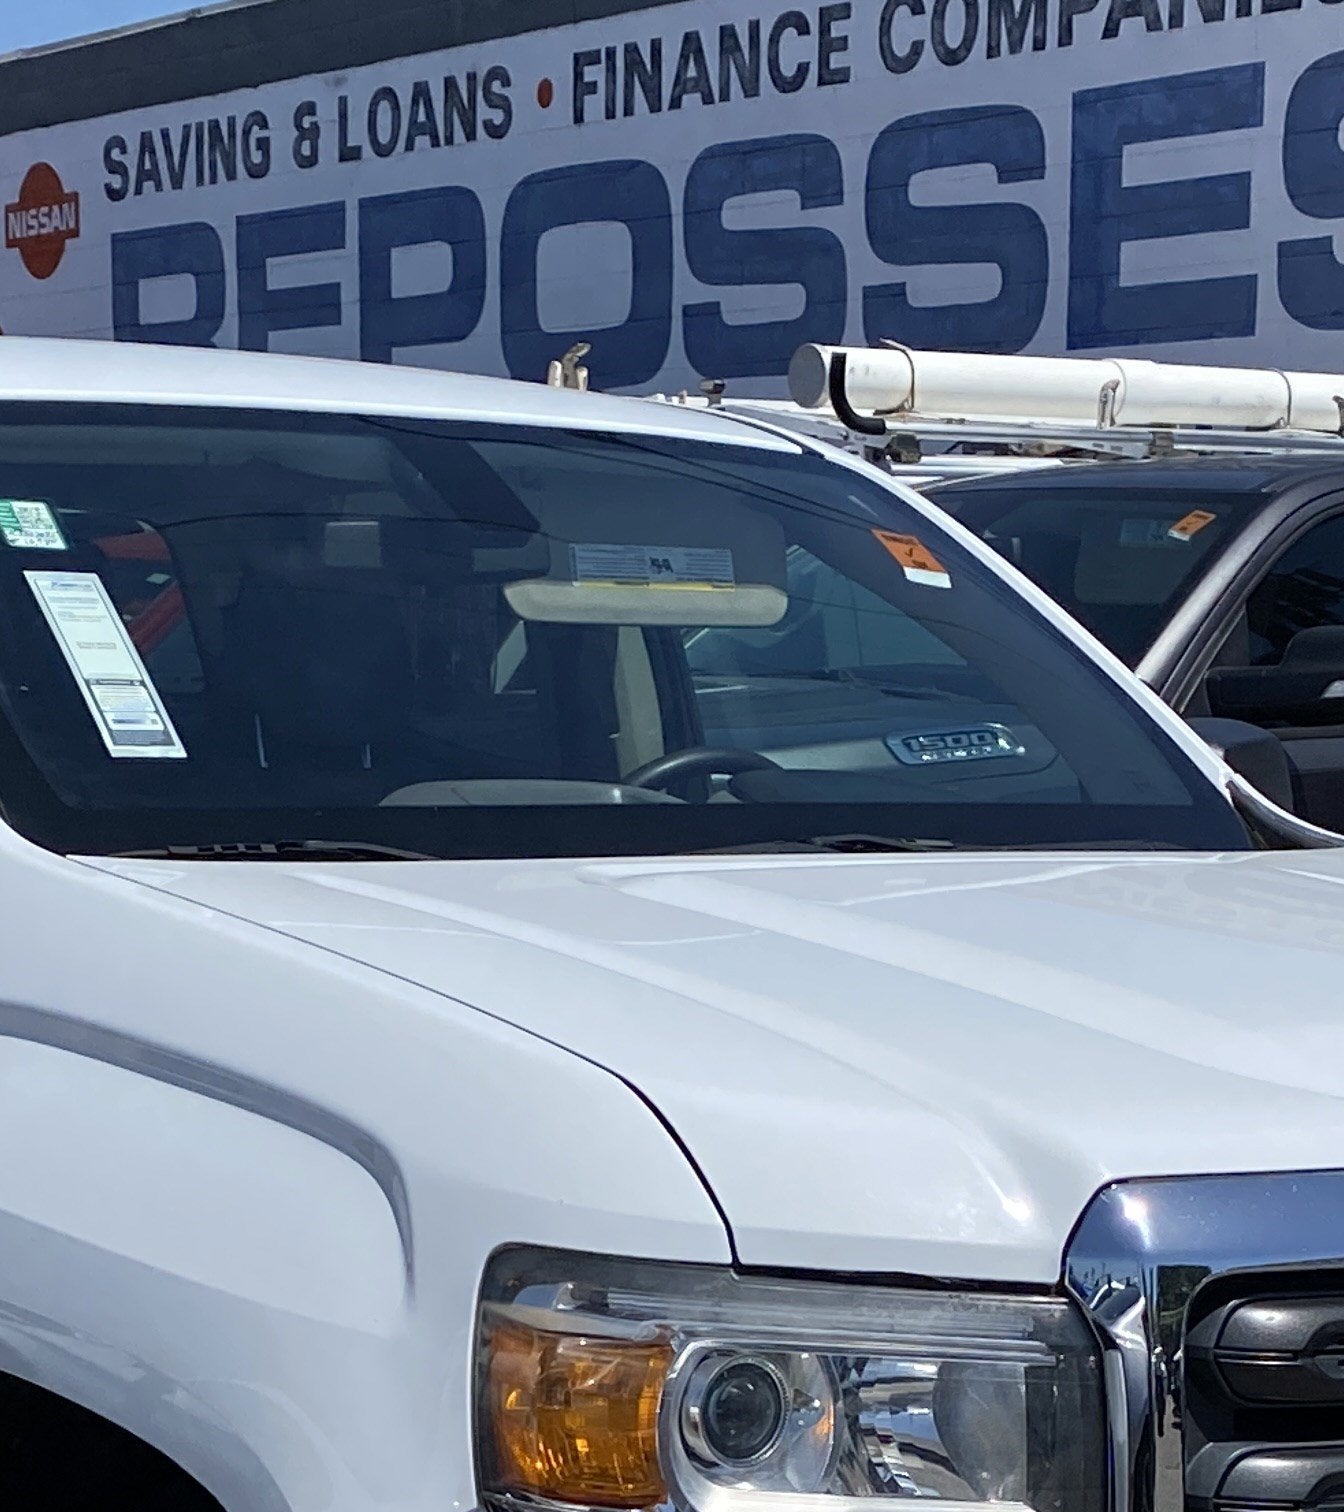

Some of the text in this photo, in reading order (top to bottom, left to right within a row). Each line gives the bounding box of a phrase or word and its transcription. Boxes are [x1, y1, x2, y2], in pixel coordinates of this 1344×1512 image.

[103, 109, 271, 202] SAVING
[293, 100, 320, 169] &
[338, 65, 513, 163] LOANS
[571, 3, 853, 125] FINANCE
[7, 203, 76, 240] NISSAN
[902, 731, 993, 752] 1500
